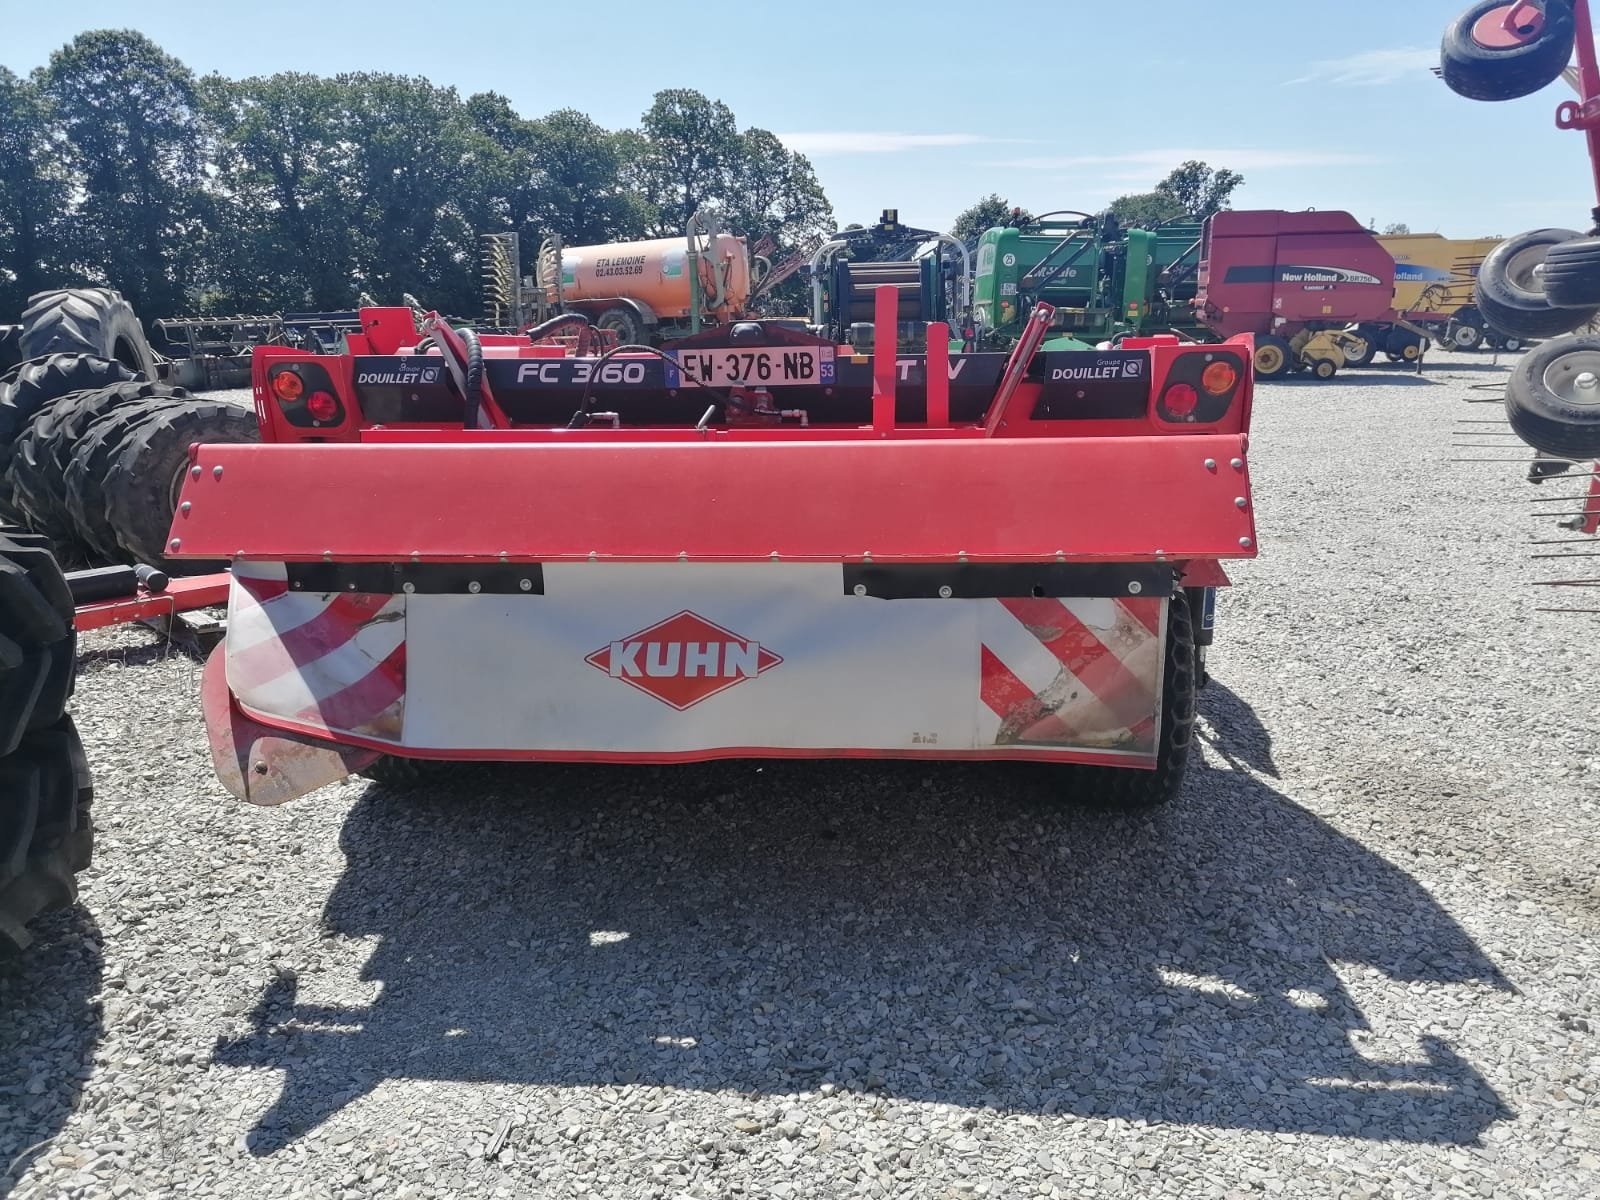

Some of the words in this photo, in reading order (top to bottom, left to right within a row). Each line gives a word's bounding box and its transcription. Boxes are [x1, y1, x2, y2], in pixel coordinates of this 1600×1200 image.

[596, 258, 610, 267] ETA
[612, 255, 646, 266] LEMOINE
[595, 265, 643, 277] 02.43.03.52.69
[1282, 273, 1303, 282] New
[1303, 273, 1337, 282] Holland
[1097, 359, 1120, 367] Groupe
[517, 363, 561, 383] FC
[820, 364, 834, 377] 53
[1052, 367, 1119, 380] DOUILLET
[358, 373, 418, 384] DOUILLET
[609, 641, 760, 678] KUHN
